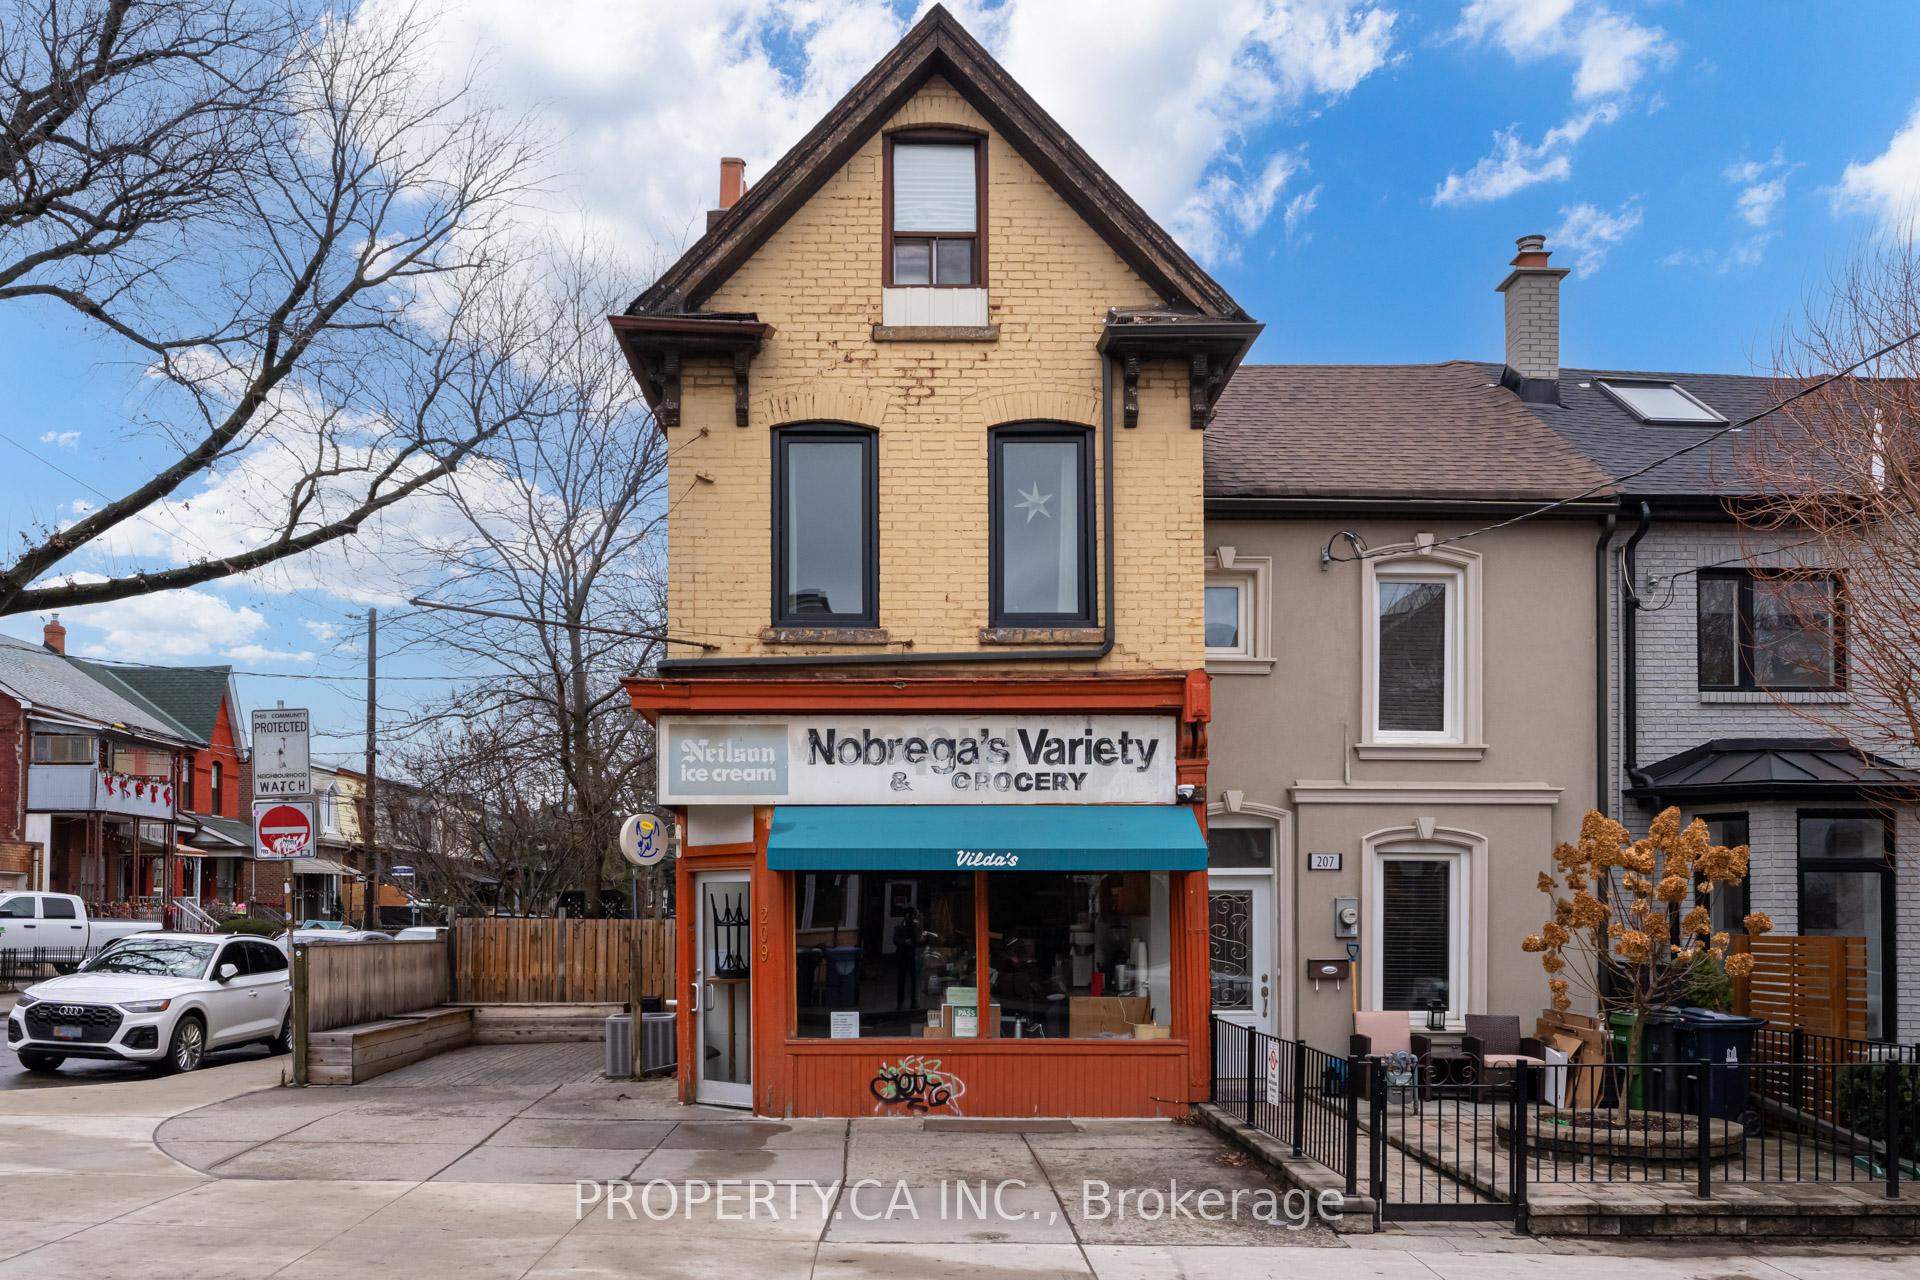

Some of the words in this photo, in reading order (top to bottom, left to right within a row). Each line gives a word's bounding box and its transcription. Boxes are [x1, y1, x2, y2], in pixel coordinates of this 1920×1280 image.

[254, 721, 307, 734] PROTECTED
[680, 738, 776, 763] Neilson
[807, 728, 1010, 775] Nobrega's
[1017, 728, 1159, 773] Variety
[680, 766, 709, 782] ice
[711, 767, 777, 782] cream
[889, 771, 913, 792] &
[951, 771, 1089, 793] GROCERY
[260, 780, 305, 793] WATCH
[956, 850, 1019, 868] Vilda's
[1316, 855, 1335, 868] 207
[759, 907, 769, 963] 209
[958, 1009, 976, 1017] PASS
